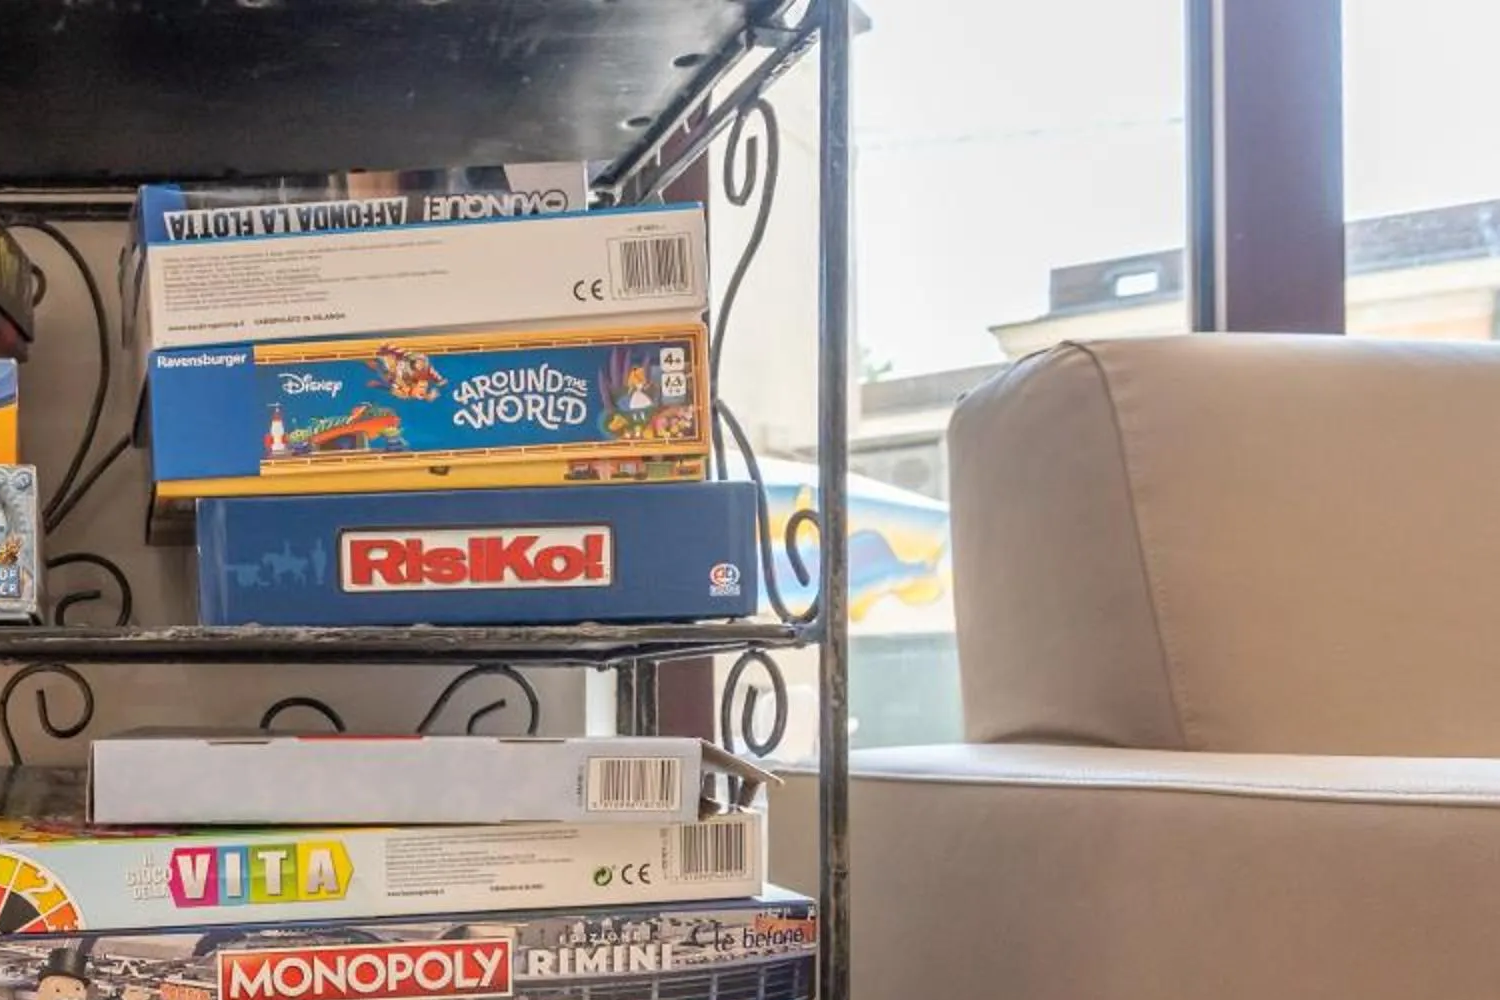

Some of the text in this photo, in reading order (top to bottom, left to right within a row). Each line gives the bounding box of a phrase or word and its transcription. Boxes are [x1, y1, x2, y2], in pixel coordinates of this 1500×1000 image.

[169, 211, 255, 241] FLOTTA
[260, 208, 290, 234] LA
[297, 201, 401, 231] AFFONDA
[156, 352, 248, 368] Ravensburger
[452, 363, 564, 404] AROUND
[453, 394, 587, 429] WORLD
[177, 848, 340, 900] VITA
[229, 949, 502, 999] MONOPOLY
[528, 944, 672, 977] RIMINI
